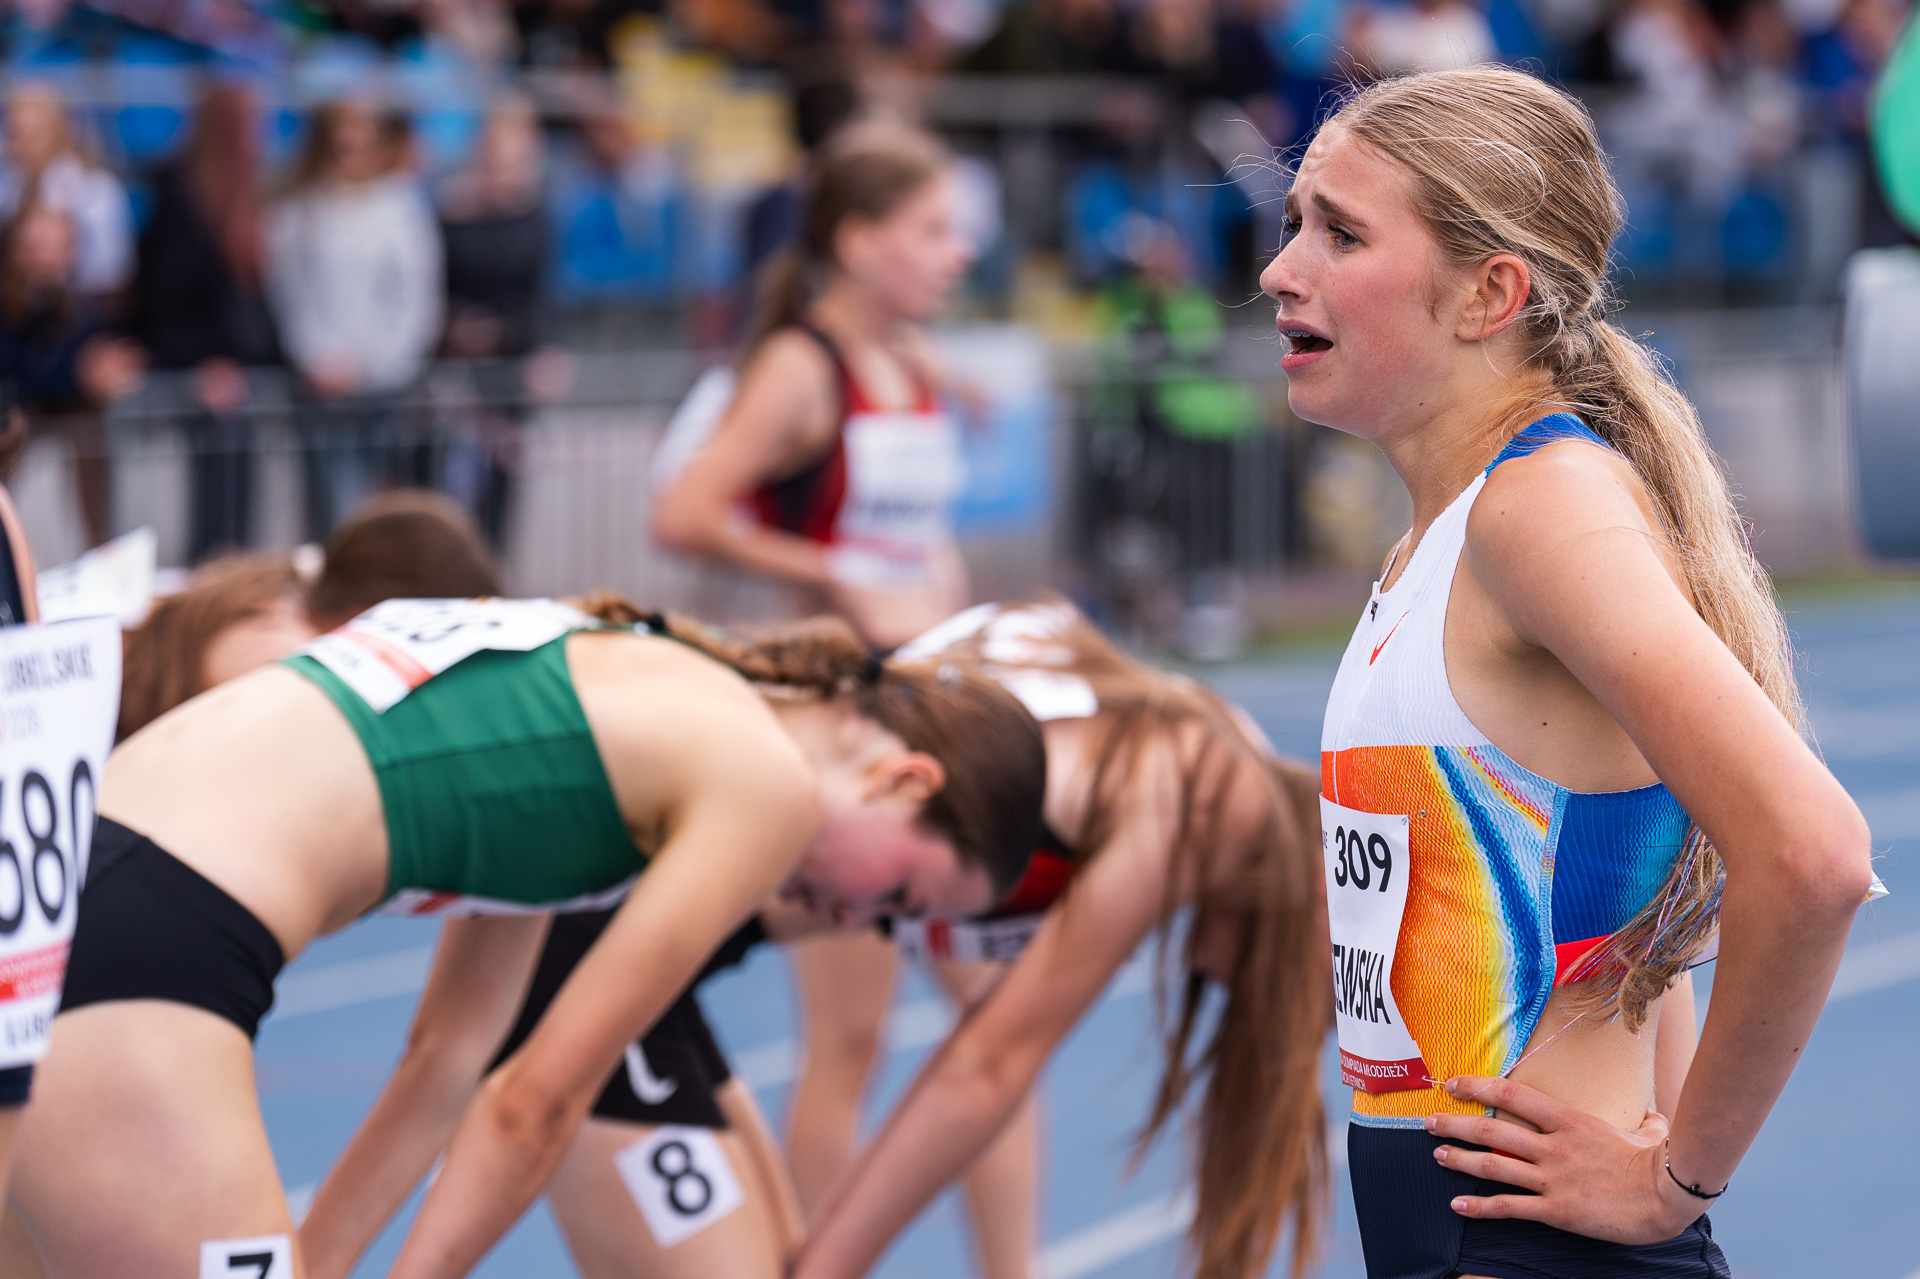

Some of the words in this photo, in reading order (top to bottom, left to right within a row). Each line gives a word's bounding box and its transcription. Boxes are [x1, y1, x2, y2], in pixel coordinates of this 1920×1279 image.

[1335, 825, 1392, 893] 309
[1333, 943, 1391, 1025] EWSKA
[1364, 1063, 1409, 1077] MŁODZIEŻY
[653, 1140, 711, 1215] 8
